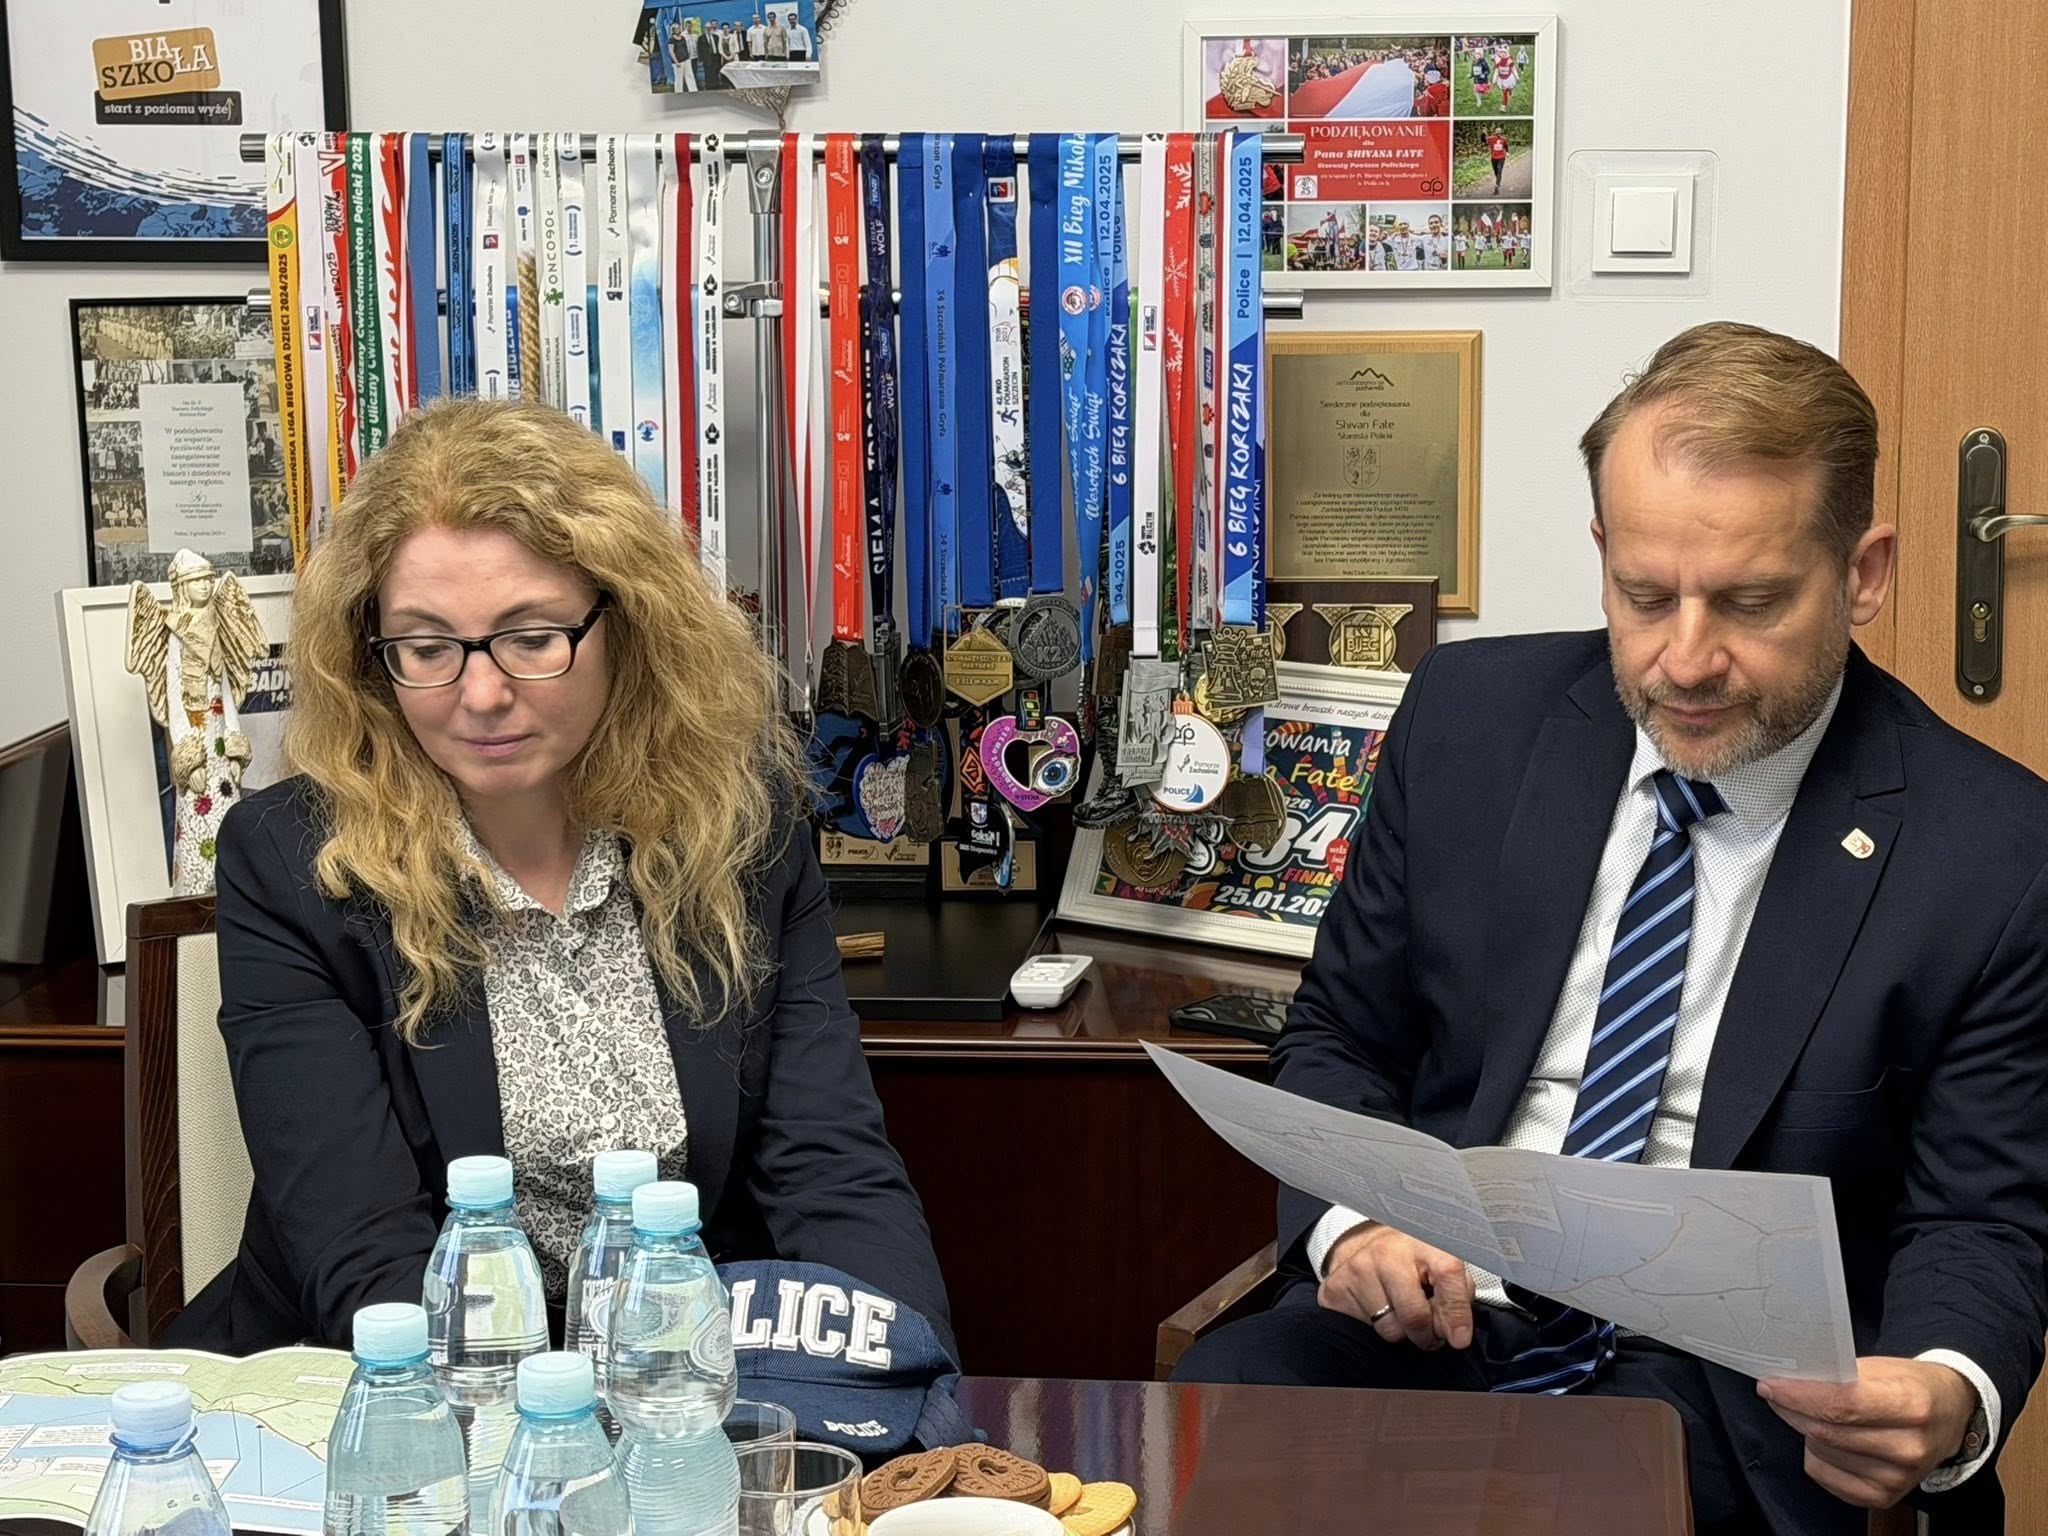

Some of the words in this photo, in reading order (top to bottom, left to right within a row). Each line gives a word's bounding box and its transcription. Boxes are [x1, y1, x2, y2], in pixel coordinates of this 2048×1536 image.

[104, 104, 132, 114] start
[135, 105, 142, 114] z
[144, 103, 195, 117] poziomu
[1310, 125, 1426, 140] PODZIĘKOWANIE
[351, 136, 364, 172] 2025
[607, 137, 616, 182] Zachodnie
[1313, 150, 1343, 159] Pana
[1347, 149, 1393, 158] SHIVANA
[1395, 149, 1425, 158] FATE
[934, 162, 943, 190] Gryfa
[351, 173, 364, 224] Policki
[608, 185, 618, 224] Pomorze
[1062, 194, 1091, 235] Bieg
[1099, 154, 1112, 241] 12.04.2025
[1238, 156, 1252, 244] 12.04.2025
[876, 219, 885, 256] WOLF
[1063, 239, 1084, 266] XII
[278, 253, 289, 312] 2024/2025
[937, 288, 945, 301] 34
[1237, 268, 1250, 319] Police
[280, 313, 292, 351] DZIECI
[283, 354, 294, 408] BIEGOWA
[995, 379, 1003, 395] PKO
[1002, 356, 1010, 406] PÓŁMARATON
[1010, 371, 1019, 406] SZCZECIN
[1110, 323, 1128, 421] KORCZAKA
[366, 372, 380, 424] Uliczny
[885, 373, 895, 409] WOLF
[287, 411, 296, 438] LIGA
[938, 413, 947, 438] Gryfa
[1230, 362, 1254, 480] KORCZAKA
[1335, 419, 1369, 430] Shivan
[1372, 419, 1395, 430] Fate
[1111, 424, 1130, 466] BIEG
[1083, 445, 1102, 521] Wesołych
[1112, 472, 1127, 486] 6
[1228, 486, 1253, 535] BIEG
[1228, 542, 1248, 558] 6
[1301, 702, 1337, 715] brzuszki
[1336, 707, 1369, 718] naszych
[1188, 766, 1219, 775] Zachodnie
[1289, 762, 1354, 791] Fate
[1163, 786, 1191, 796] POLICE
[730, 1278, 898, 1370] LICE
[823, 1420, 890, 1438] POLICE
